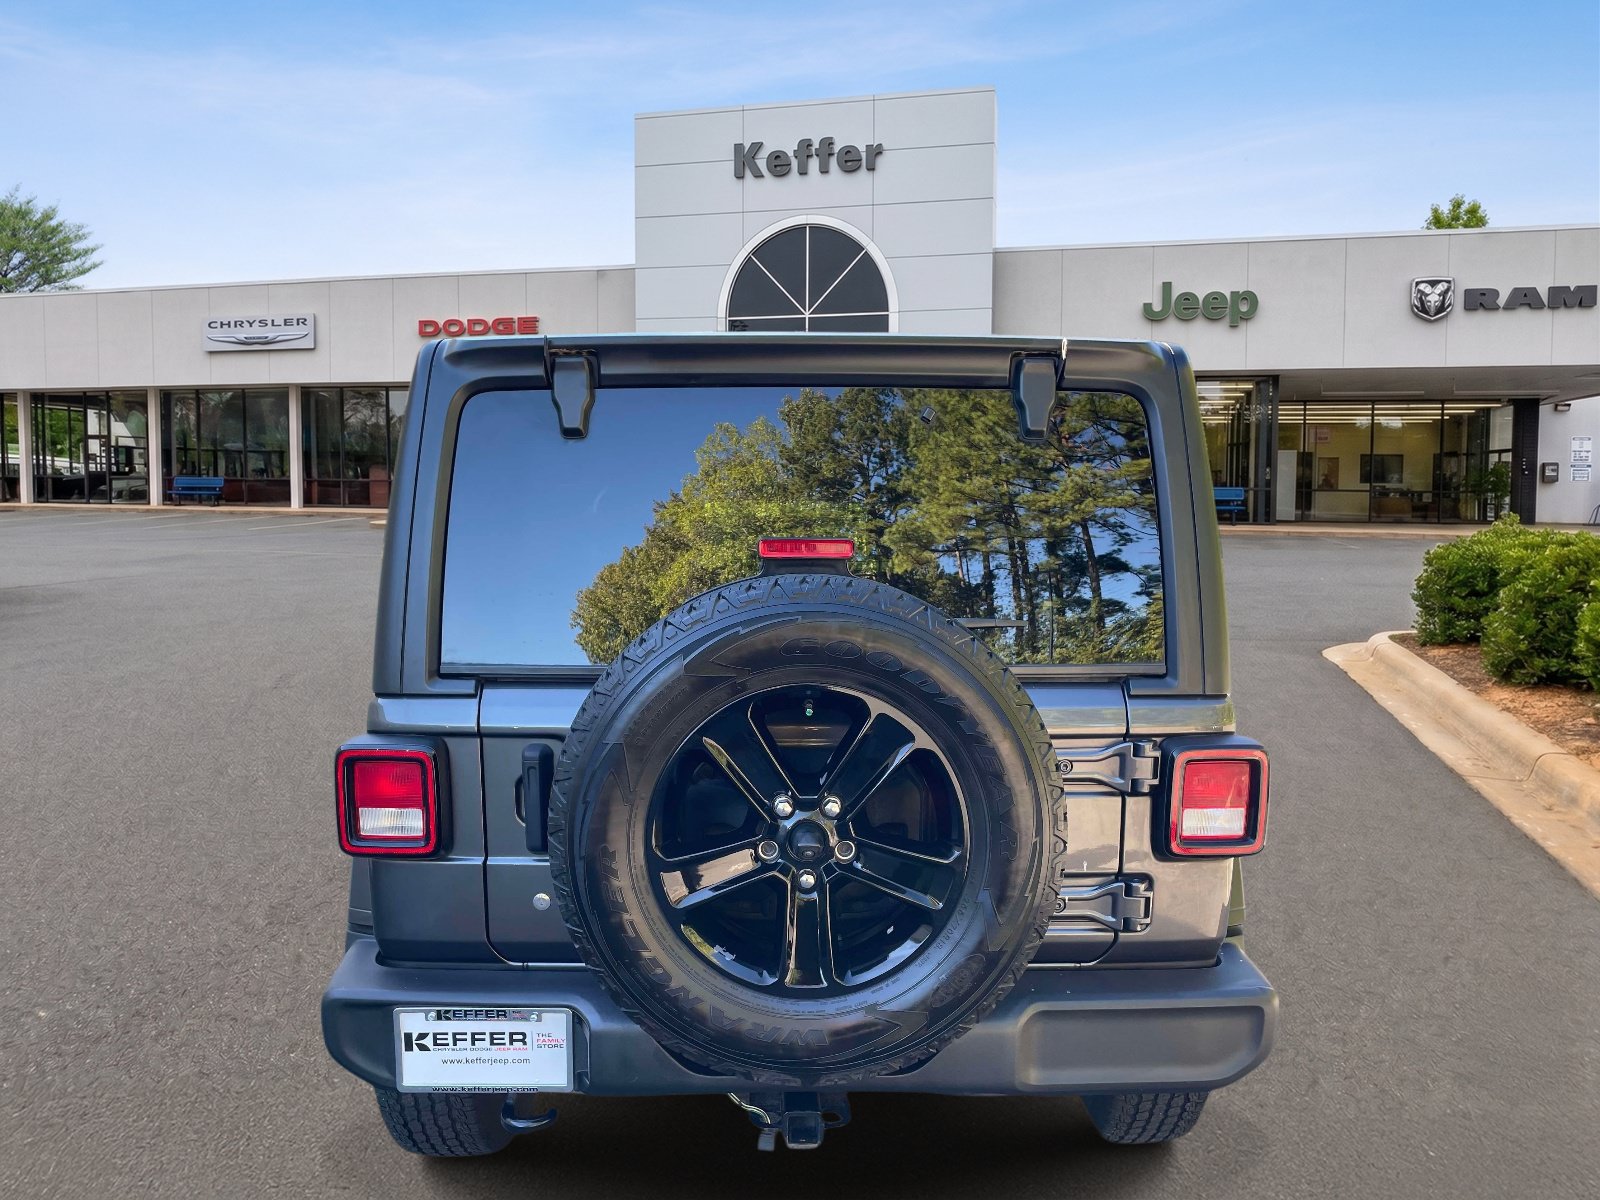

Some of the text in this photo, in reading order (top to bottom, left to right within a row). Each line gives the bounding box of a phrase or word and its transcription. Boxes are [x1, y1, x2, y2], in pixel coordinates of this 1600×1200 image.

[733, 136, 884, 179] Keffer
[1142, 281, 1260, 327] Jeep
[1463, 284, 1599, 312] RAM
[207, 317, 309, 329] CHRYSLER
[418, 316, 540, 338] DODGE
[780, 637, 1020, 861] GOODYEAR
[600, 843, 830, 1047] WRANGLER
[436, 1009, 508, 1020] KEFFER
[403, 1031, 528, 1052] KEFFER
[441, 1056, 531, 1066] www.kefferjeep.com
[432, 1086, 539, 1094] www.kefferjeep.com
